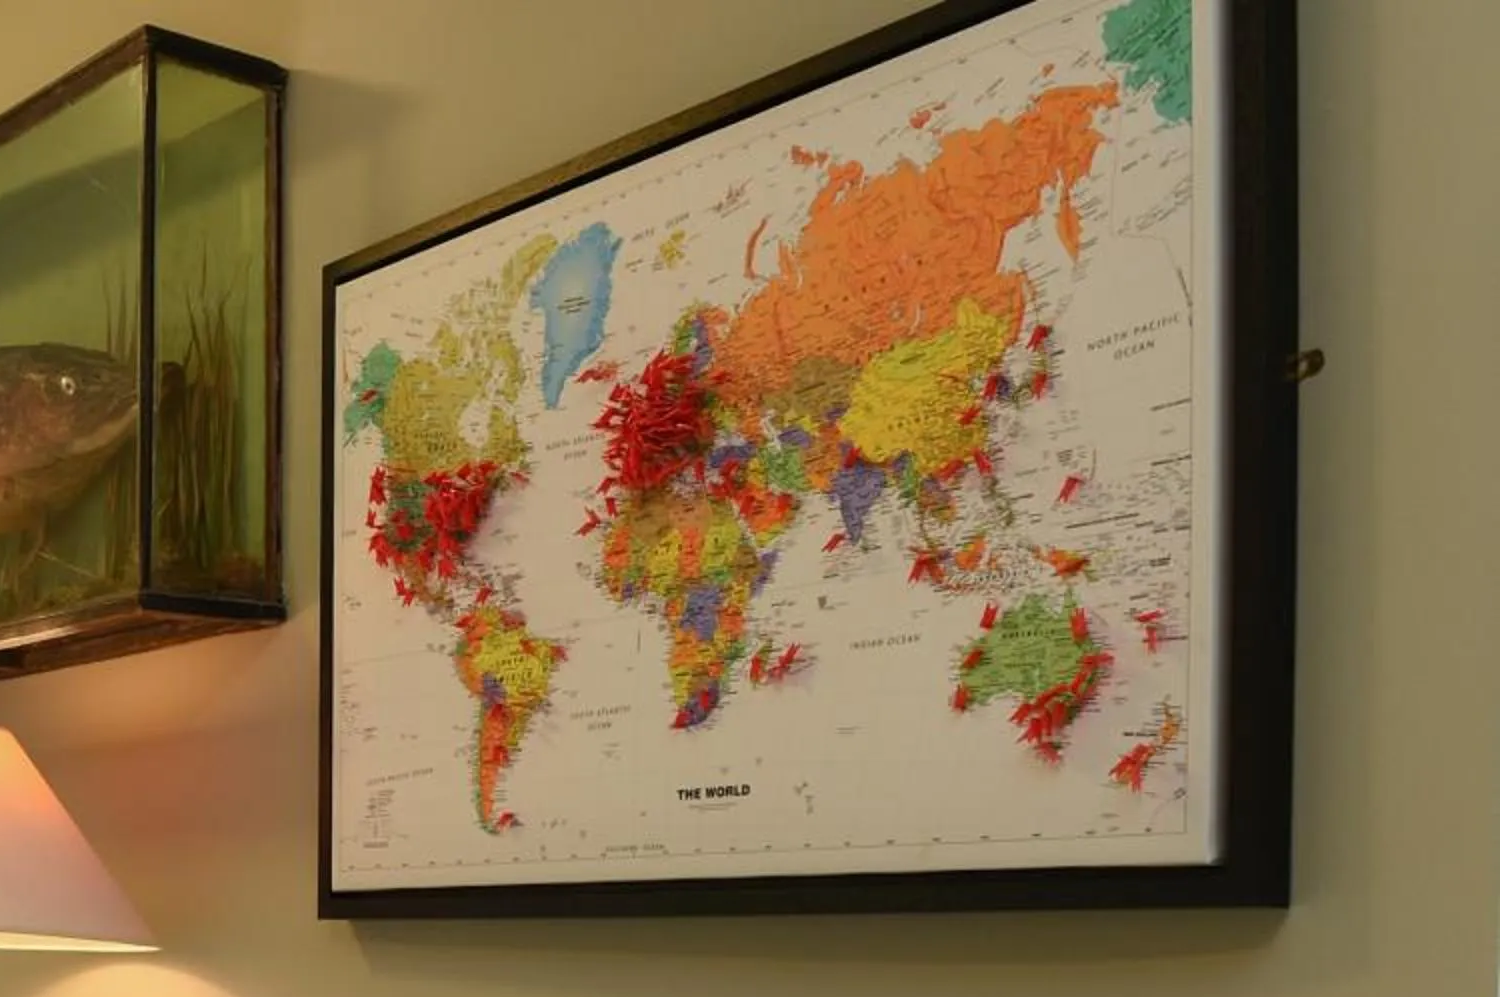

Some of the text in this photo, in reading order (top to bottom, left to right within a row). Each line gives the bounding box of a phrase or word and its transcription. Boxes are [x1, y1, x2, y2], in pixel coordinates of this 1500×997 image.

[1113, 340, 1155, 361] OCEAN
[676, 783, 752, 801] THE WORLD
